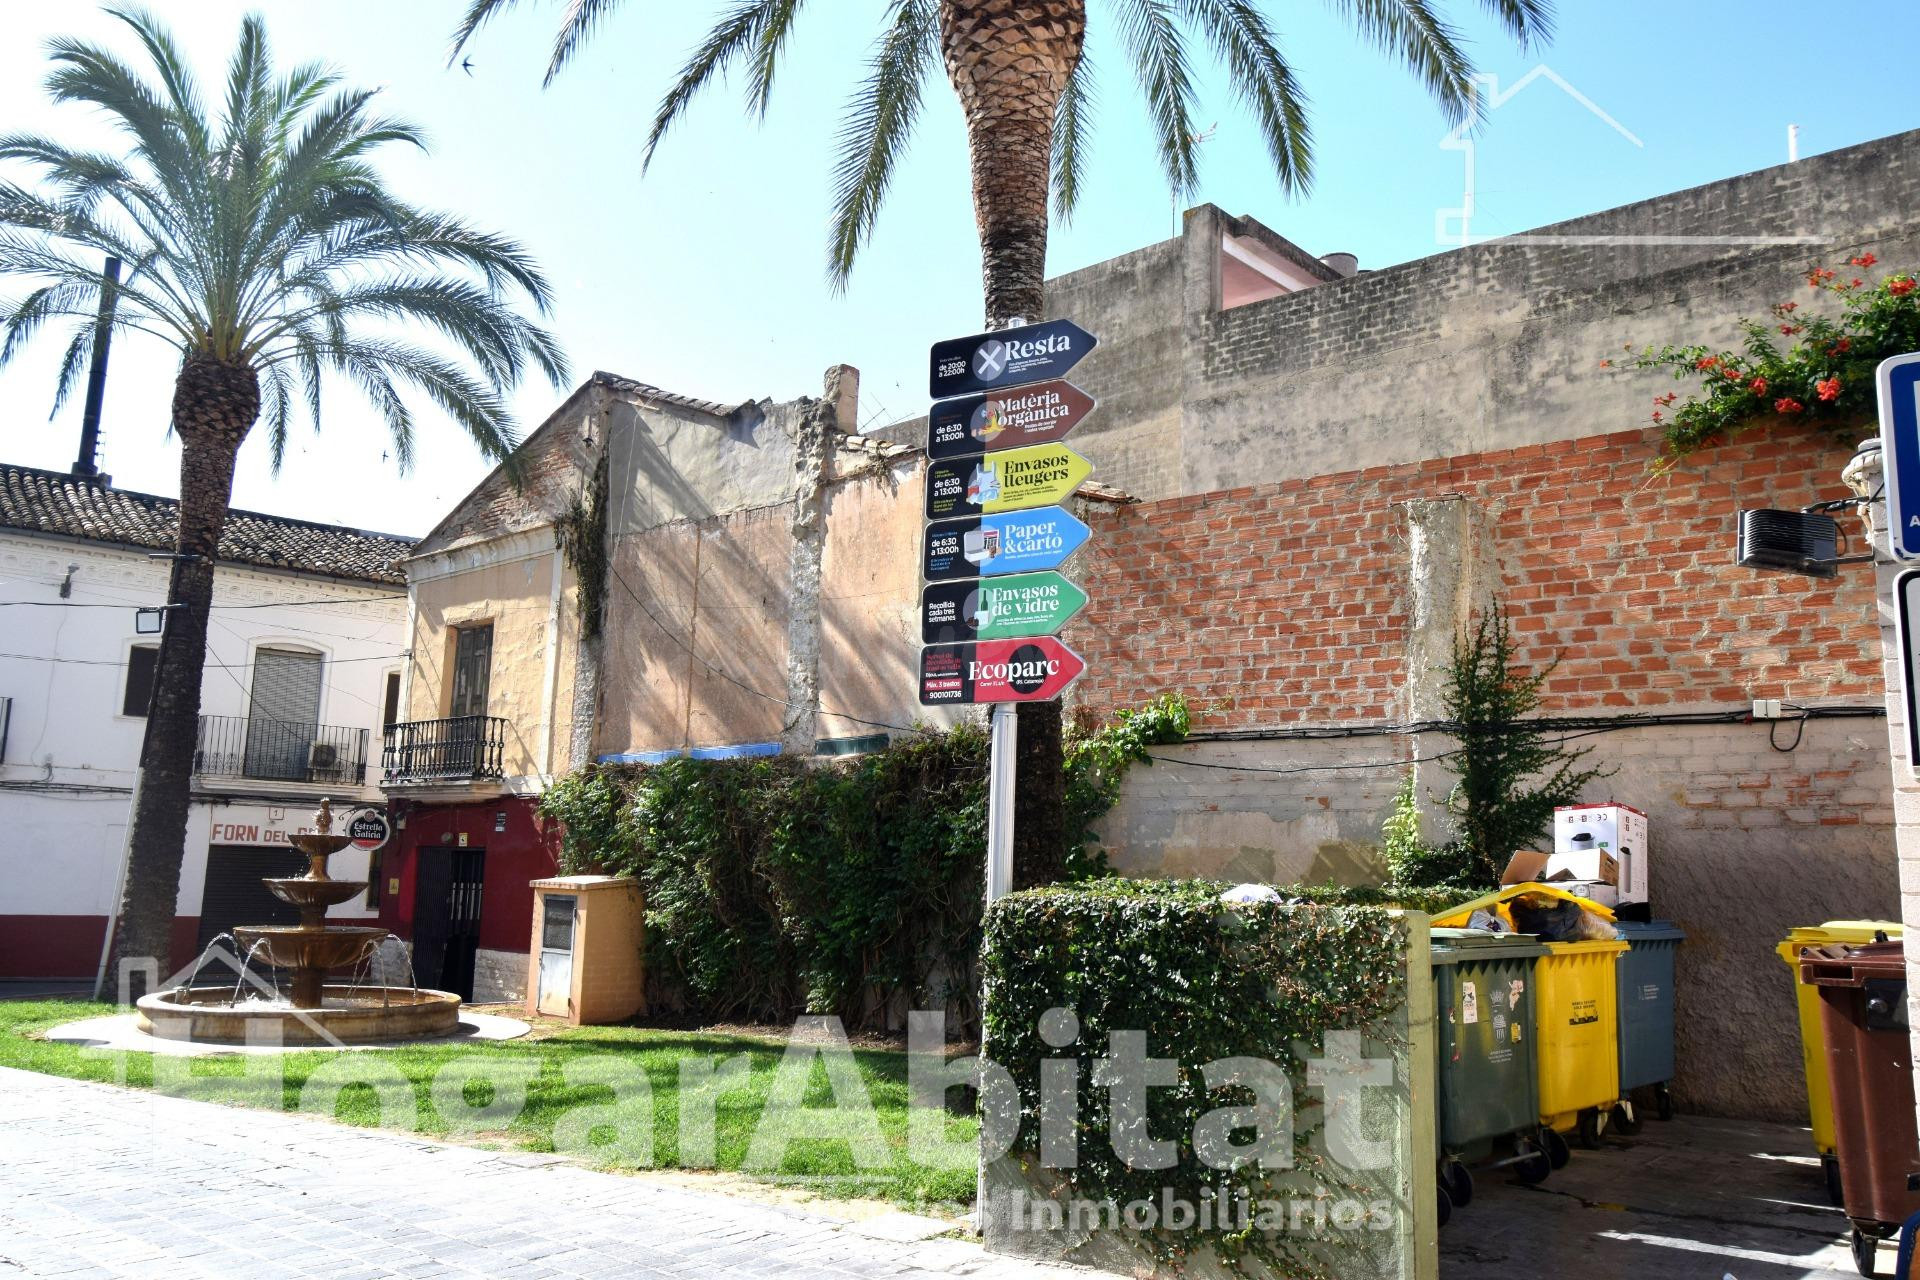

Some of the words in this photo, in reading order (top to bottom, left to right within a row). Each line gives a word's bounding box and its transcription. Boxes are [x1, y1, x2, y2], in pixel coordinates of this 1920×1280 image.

[1004, 334, 1071, 361] Resta
[947, 360, 967, 370] 20:00
[998, 391, 1060, 413] Matèria
[997, 403, 1069, 428] orgànica
[936, 427, 946, 435] de
[946, 423, 962, 433] 6:30
[941, 431, 965, 442] 13:00h
[1004, 455, 1069, 475] Envasos
[934, 480, 944, 488] de
[944, 477, 960, 487] 6:30
[1004, 468, 1069, 488] lleugers
[939, 485, 963, 496] 13:00h
[1005, 521, 1056, 540] Paper
[931, 539, 941, 547] de
[941, 537, 957, 546] 6:30
[936, 545, 959, 555] 13:00h
[992, 585, 1059, 602] Envasos
[928, 608, 943, 617] cada
[991, 602, 1012, 616] de
[1015, 598, 1060, 614] vidre
[968, 659, 1060, 683] Ecoparc
[211, 823, 259, 842] FORN
[263, 829, 289, 843] DEL
[353, 822, 383, 832] Estrella
[354, 830, 381, 839] Galicia
